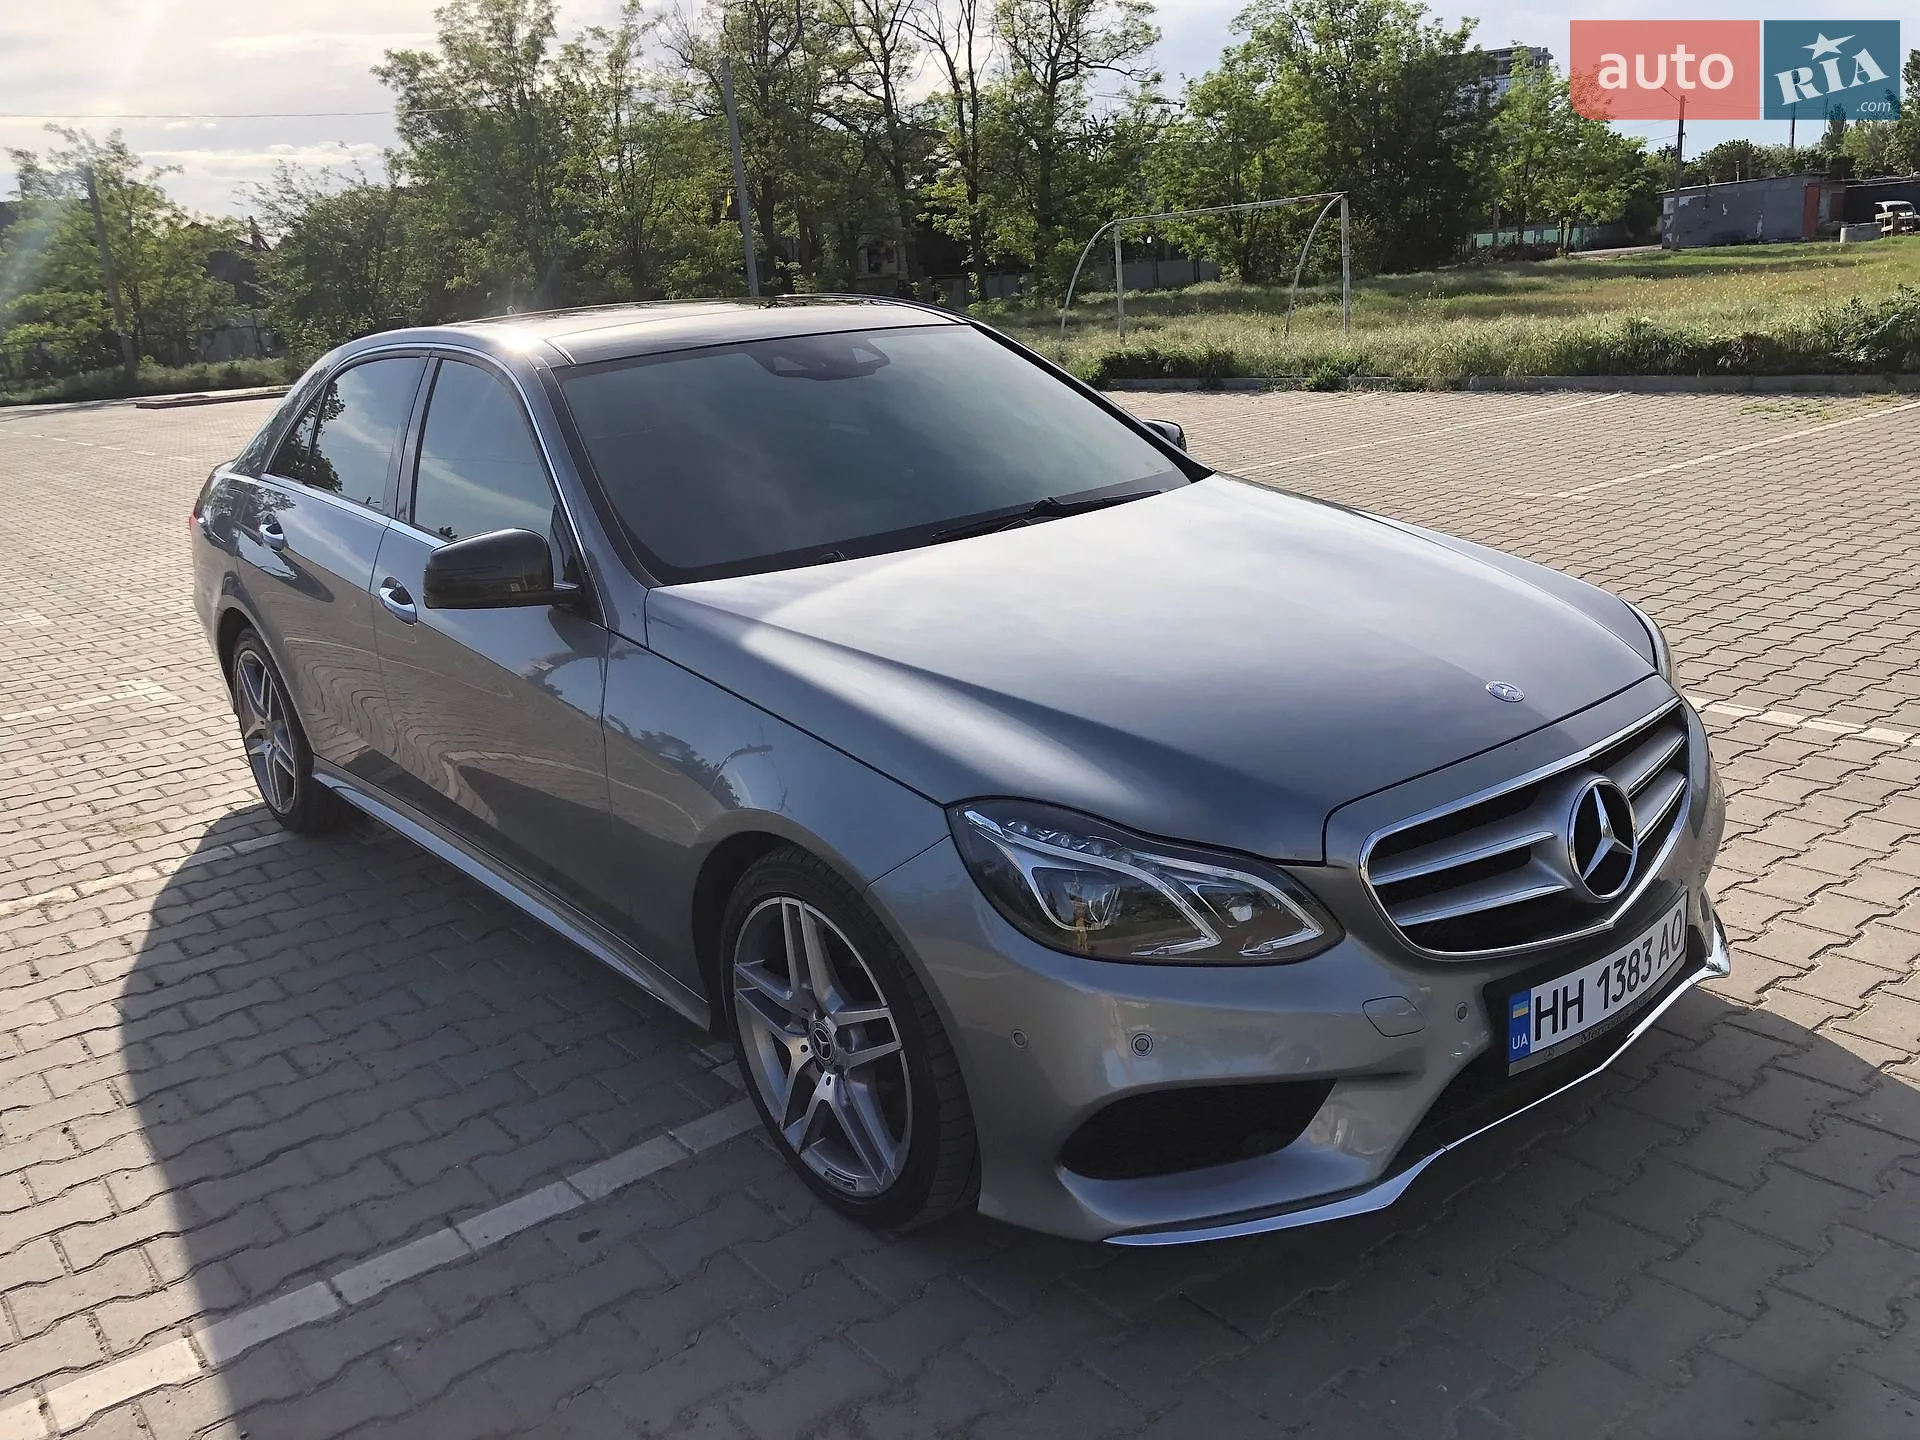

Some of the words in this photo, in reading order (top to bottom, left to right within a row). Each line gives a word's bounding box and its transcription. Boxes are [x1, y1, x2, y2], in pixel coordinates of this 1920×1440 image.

[1534, 978, 1585, 1042] HH
[1597, 936, 1654, 1011] 1383
[1657, 908, 1682, 970] AO
[1512, 1034, 1529, 1050] UA
